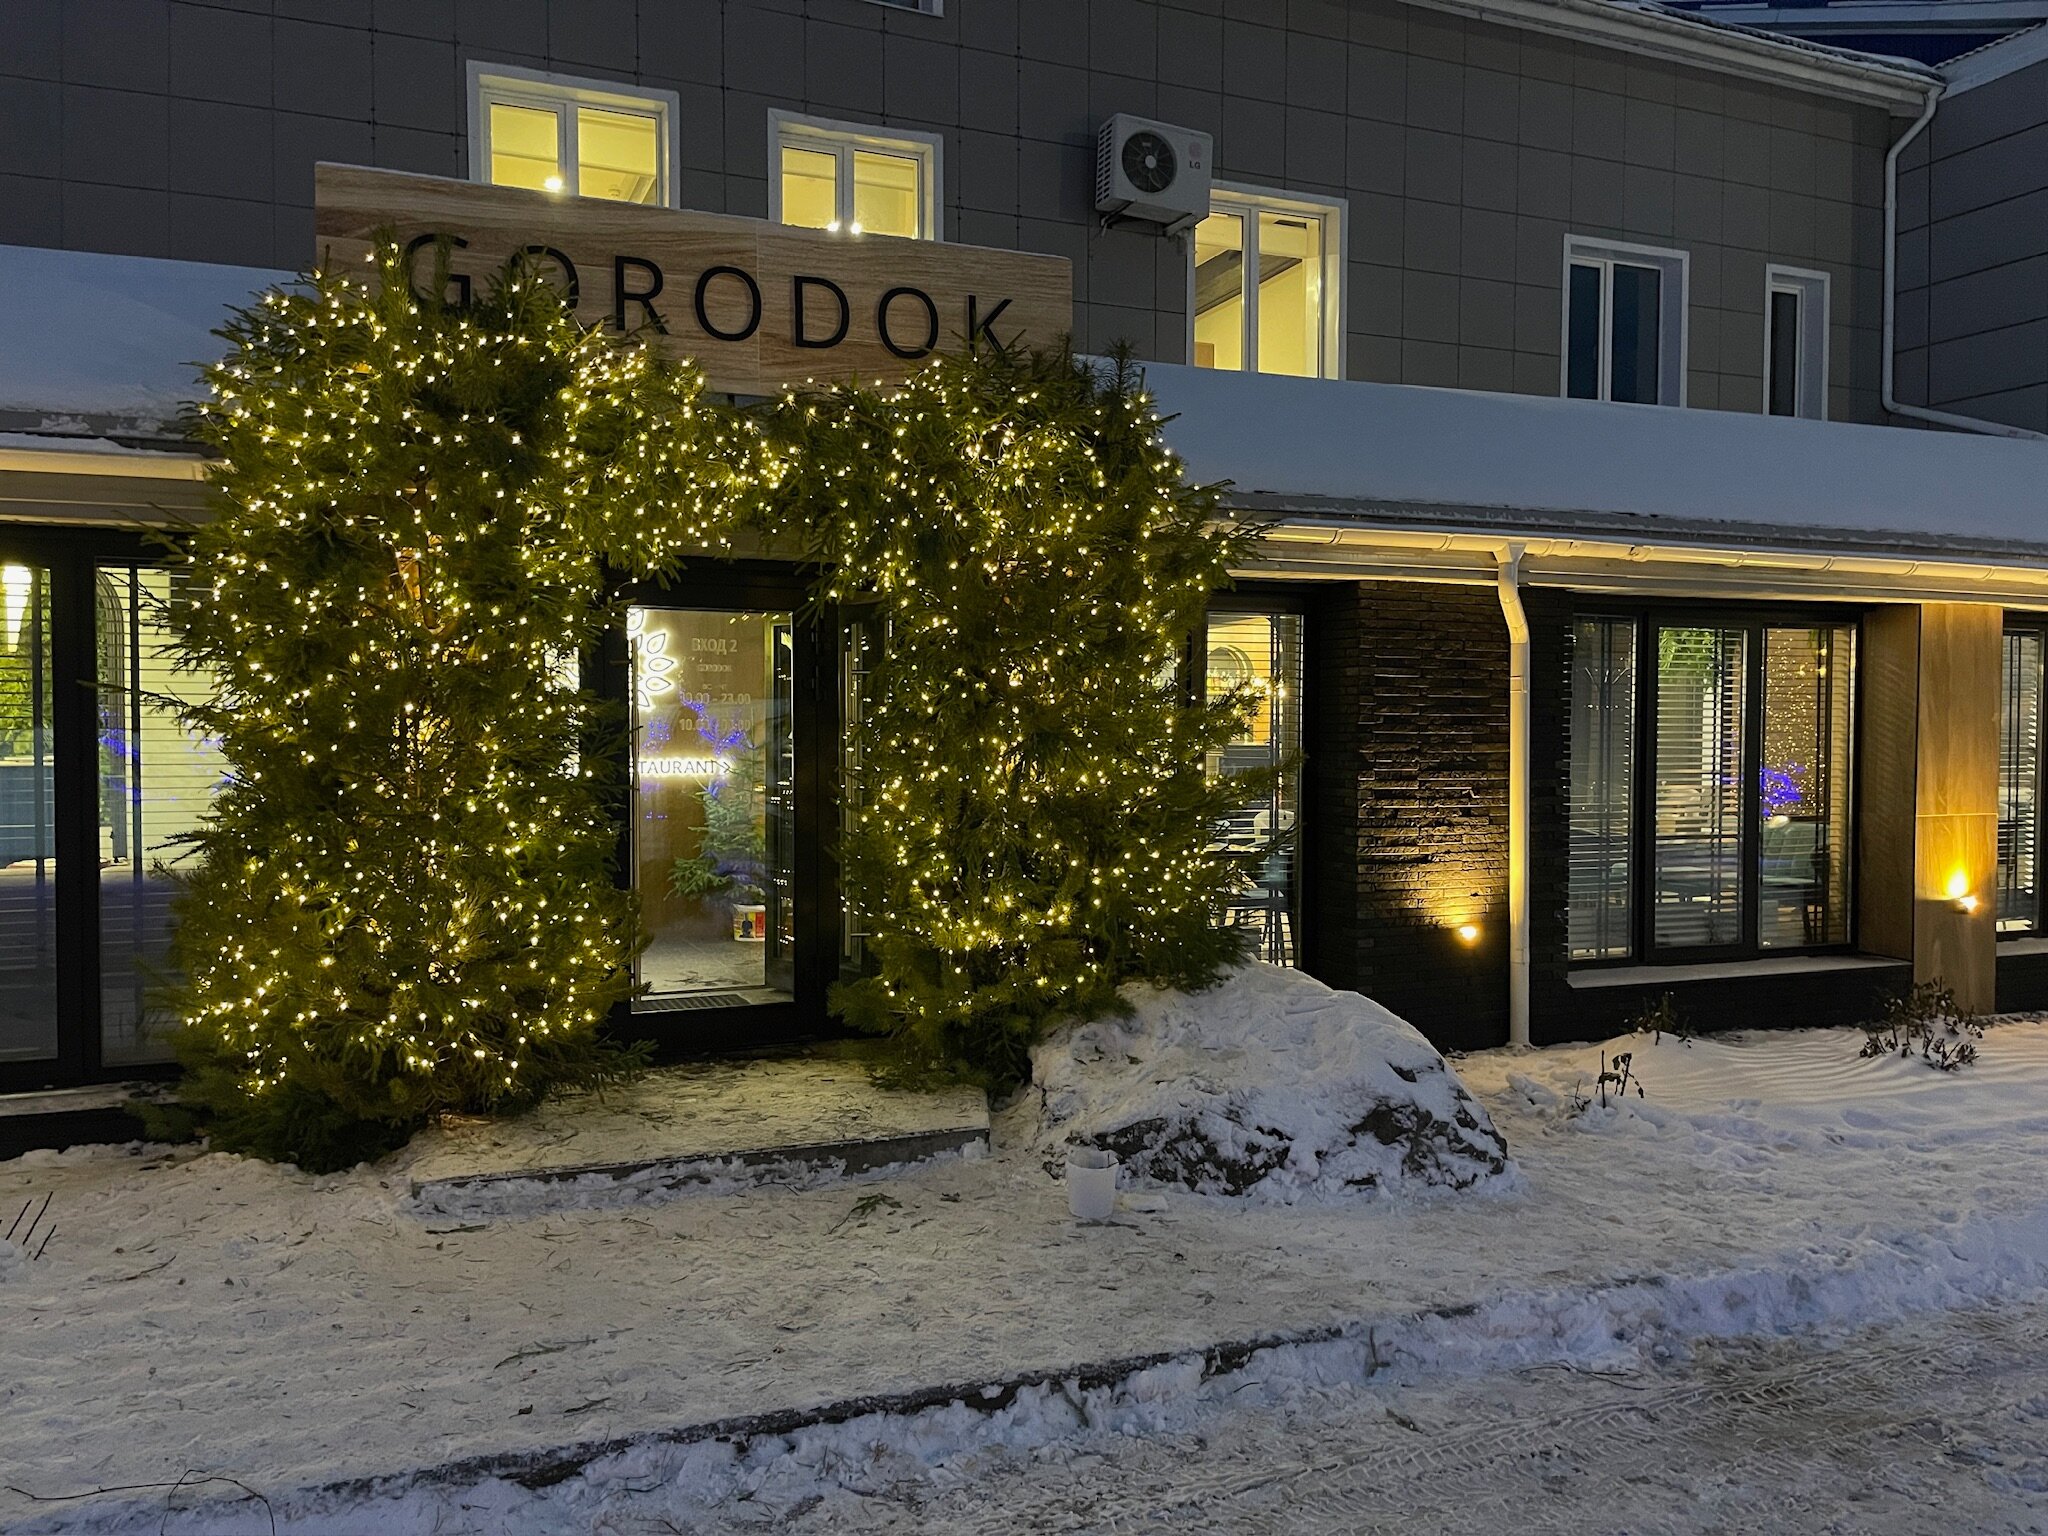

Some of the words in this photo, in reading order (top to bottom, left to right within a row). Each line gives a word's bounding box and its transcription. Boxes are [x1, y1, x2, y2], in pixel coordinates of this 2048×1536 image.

[1189, 161, 1201, 170] LG
[405, 232, 1012, 360] GORODOK
[692, 637, 727, 655] ВХОД
[729, 639, 738, 653] 2
